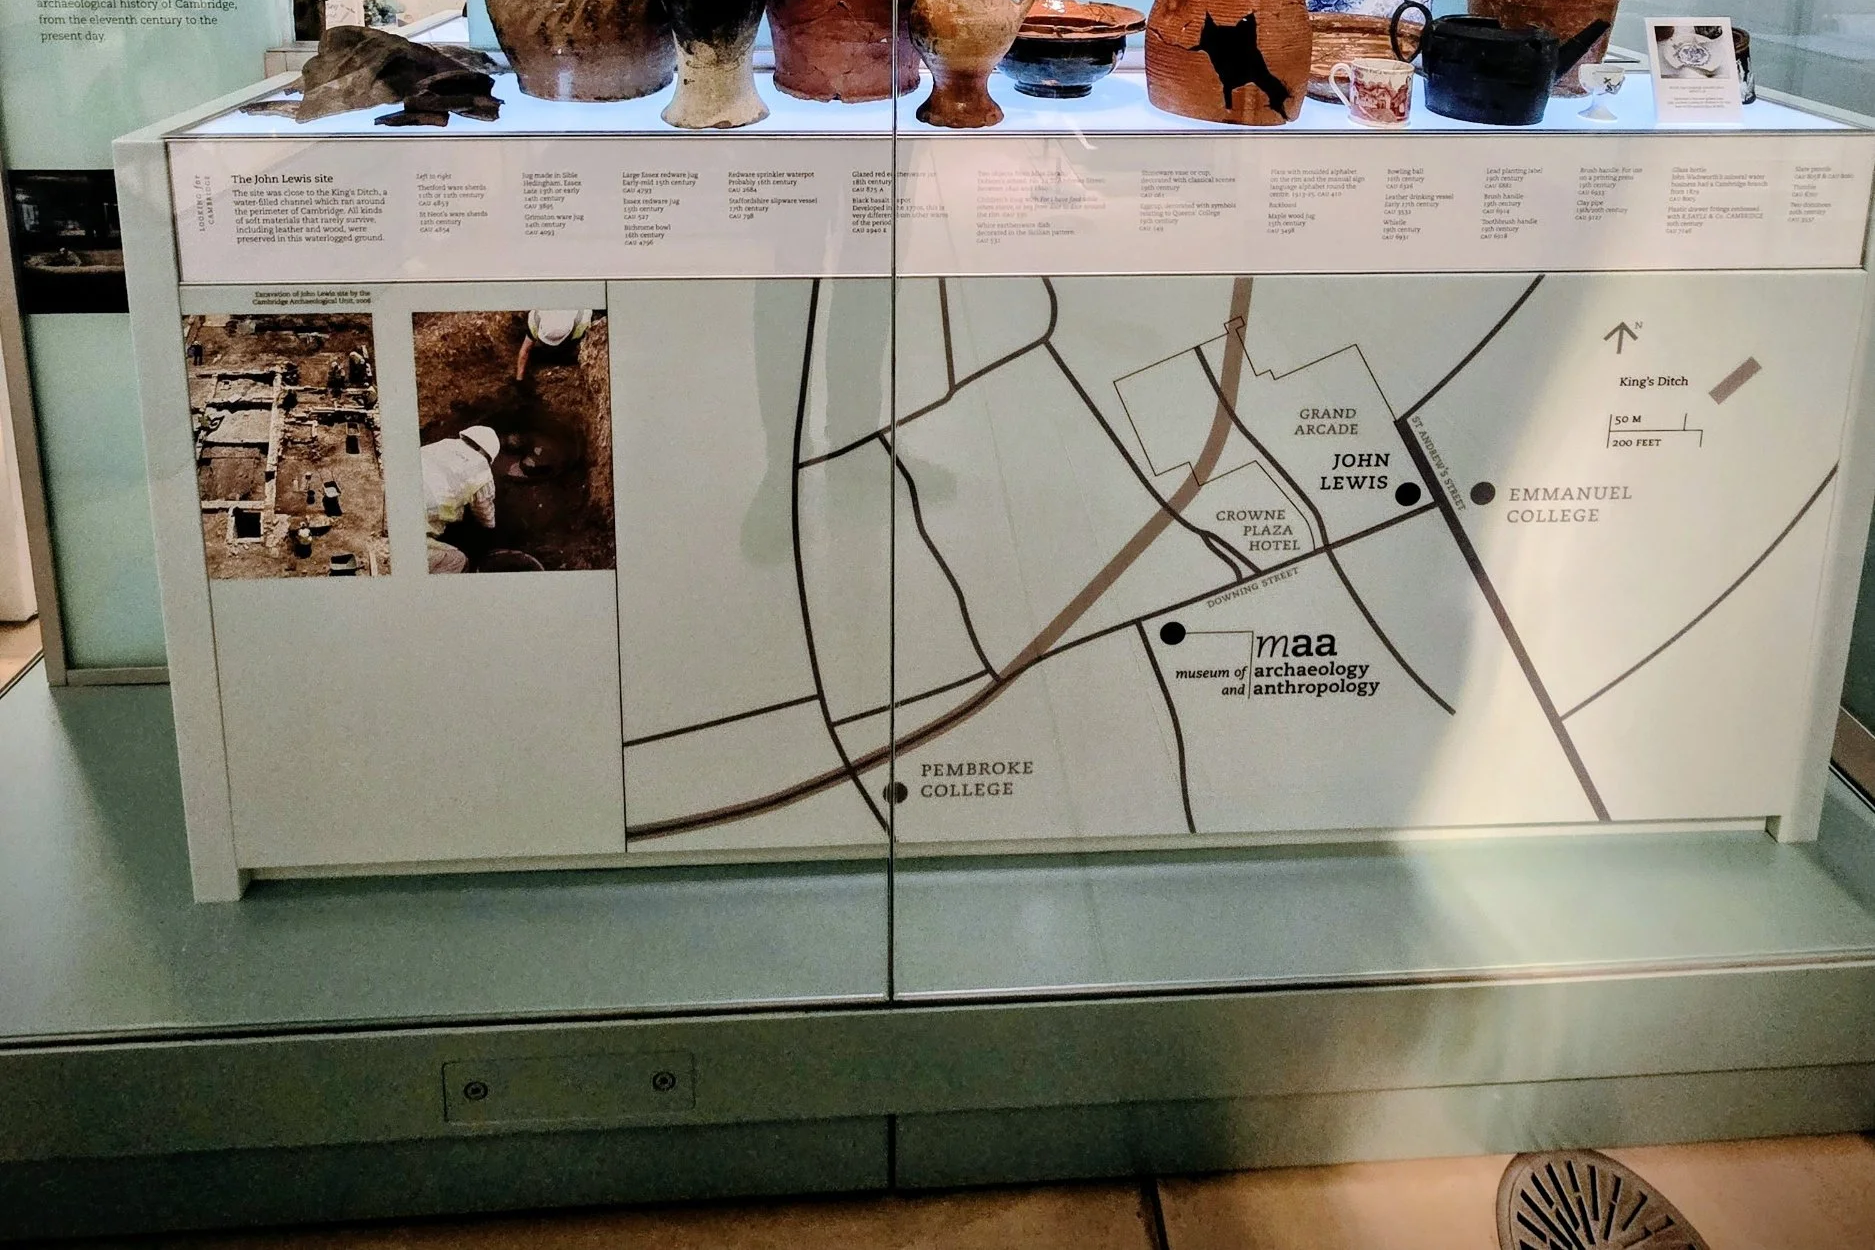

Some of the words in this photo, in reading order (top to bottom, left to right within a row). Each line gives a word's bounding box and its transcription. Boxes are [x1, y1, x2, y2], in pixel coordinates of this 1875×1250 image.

[161, 0, 172, 8] of
[175, 0, 238, 11] Cambridge,
[39, 14, 65, 24] from
[69, 15, 87, 24] the
[90, 15, 137, 25] eleventh
[141, 17, 182, 27] century
[186, 17, 197, 25] to
[200, 15, 218, 25] the
[41, 32, 83, 43] present
[193, 174, 203, 190] for
[231, 175, 252, 183] The
[254, 175, 279, 185] John
[281, 174, 312, 183] Lewis
[314, 174, 334, 183] site
[232, 189, 248, 197] The
[331, 189, 355, 197] King's
[357, 189, 381, 197] Ditch,
[233, 198, 278, 206] water-filled
[280, 198, 313, 206] channel
[196, 194, 205, 231] LOOKING
[250, 208, 288, 216] perimeter
[291, 207, 299, 215] of
[262, 216, 300, 224] materials
[321, 216, 344, 225] rarely
[236, 226, 274, 234] including
[275, 225, 303, 233] leather
[305, 225, 321, 233] and
[237, 235, 275, 244] preserved
[304, 234, 353, 243] waterlogged
[1634, 321, 1644, 330] N
[1657, 376, 1689, 386] Ditch
[1300, 408, 1357, 419] GRAND
[1615, 415, 1629, 425] 50
[1631, 415, 1642, 423] M
[1294, 424, 1358, 435] ARCADE
[1612, 439, 1633, 447] 200
[1636, 438, 1662, 447] FEET
[1332, 453, 1390, 470] JOHN
[1411, 416, 1424, 428] ST
[1444, 478, 1466, 511] STREET
[1320, 475, 1388, 490] LEWIS
[1509, 486, 1633, 501] EMMANUEL
[1216, 510, 1285, 521] CROWNE
[1506, 508, 1600, 523] COLLEGE
[1243, 525, 1293, 536] PLAZA
[1249, 540, 1300, 551] HOTEL
[1207, 583, 1259, 608] DOWNING
[1261, 567, 1299, 587] STREET
[1256, 633, 1338, 658] maa
[1176, 668, 1230, 679] museum
[1234, 666, 1248, 680] of
[1254, 661, 1370, 679] archaeology
[1222, 684, 1245, 696] and
[1253, 679, 1380, 697] anthropology
[921, 761, 1034, 778] PEMBROKE
[920, 782, 1014, 798] COLLEGE
